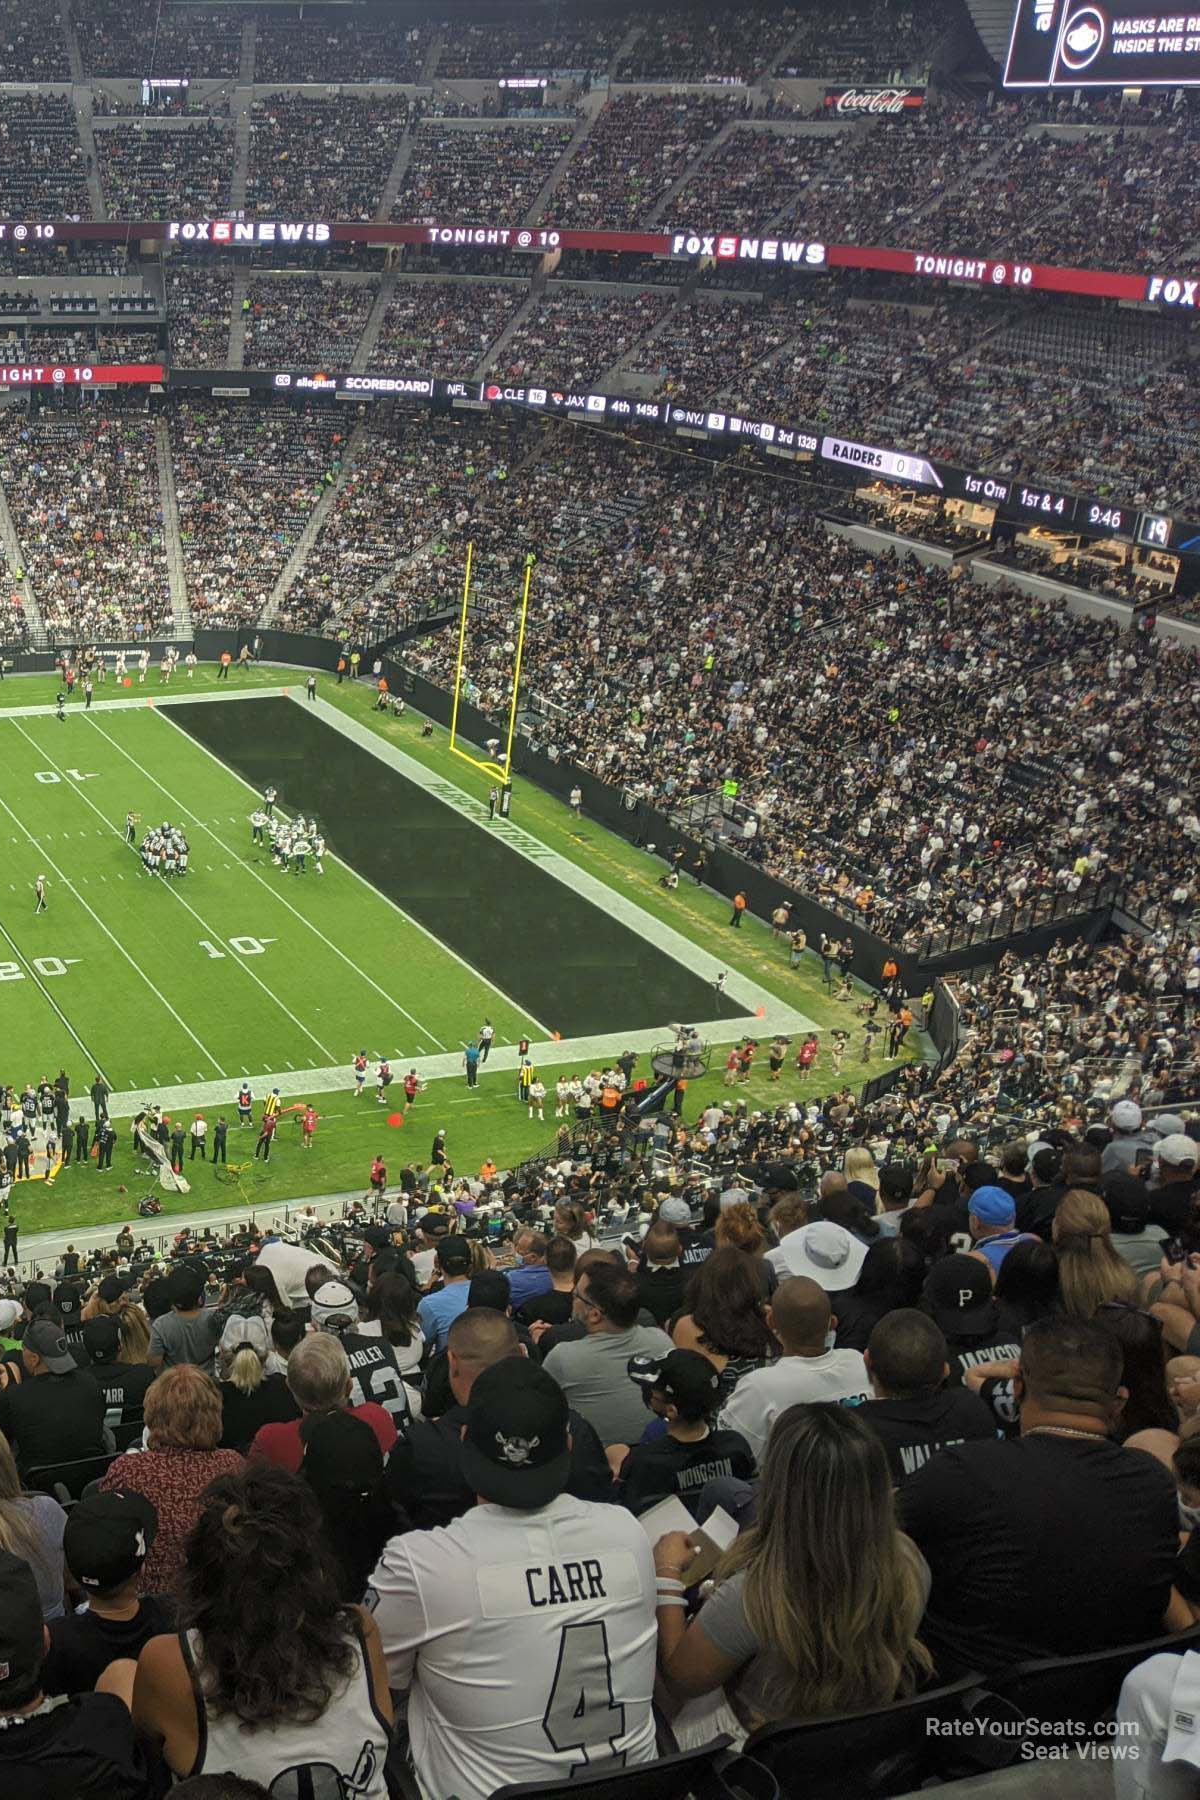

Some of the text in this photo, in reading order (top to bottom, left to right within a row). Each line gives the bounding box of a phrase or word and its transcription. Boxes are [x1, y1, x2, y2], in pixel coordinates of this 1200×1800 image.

[1112, 17, 1155, 35] MASKS
[1157, 17, 1184, 34] ARE
[1112, 38, 1154, 54] INSIDE
[1157, 37, 1182, 53] THE
[837, 89, 910, 112] Coca-Cola
[14, 225, 28, 240] @
[35, 224, 54, 238] 10
[169, 223, 330, 241] FOX 5 NEWS
[429, 228, 560, 246] TONIGHT @ 10
[672, 235, 826, 264] FOX 5 NEWS
[914, 255, 1032, 285] TONIGHT @ 10
[1148, 277, 1196, 306] FOX
[51, 368, 66, 382] @
[73, 368, 92, 381] 10
[297, 377, 337, 389] allegiant
[345, 377, 429, 392] SCOREBOARD
[447, 383, 467, 396] NFL
[504, 389, 524, 400] CLE
[565, 395, 585, 408] JAX
[611, 400, 631, 413] 4th
[636, 402, 659, 417] 1456
[686, 411, 705, 425] NYJ
[742, 420, 760, 436] NYG
[778, 429, 793, 444] 3rd
[797, 434, 817, 450] 1328
[832, 443, 882, 467] RAIDERS
[965, 475, 1168, 543] 1ST QTR 1ST & 4 9:46 19
[199, 936, 265, 959] 10
[241, 1095, 250, 1105] K
[958, 1289, 973, 1307] P
[347, 1345, 386, 1370] TABLER
[102, 1387, 124, 1404] ARR
[525, 1558, 607, 1608] CARR
[542, 1619, 626, 1780] 4
